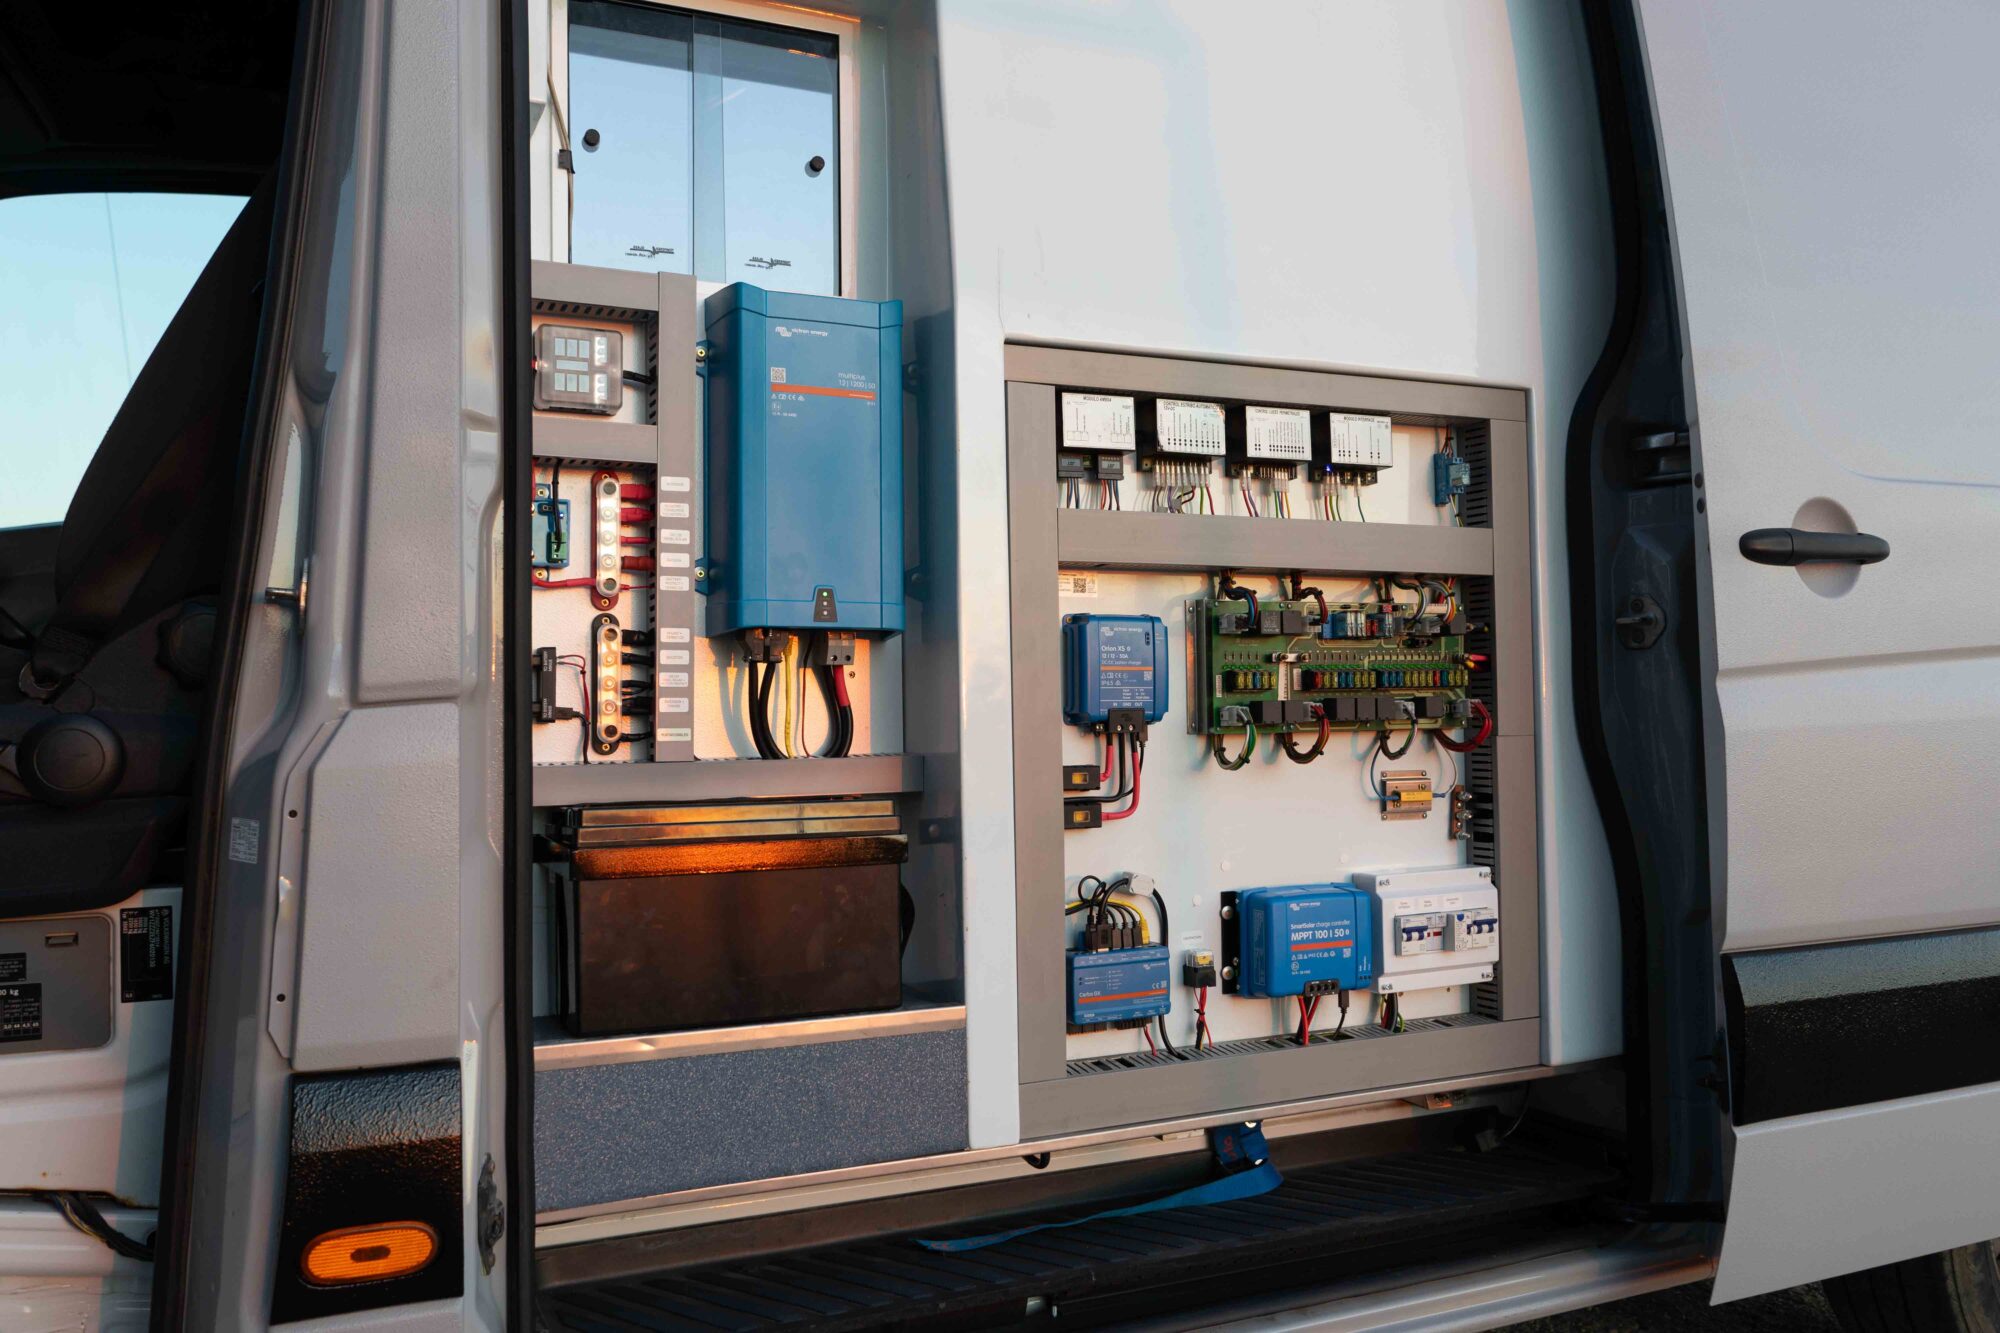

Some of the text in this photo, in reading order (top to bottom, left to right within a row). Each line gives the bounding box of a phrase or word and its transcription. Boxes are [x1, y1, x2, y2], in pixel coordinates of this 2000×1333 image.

[1291, 931, 1312, 941] MPPT
[1314, 930, 1328, 938] 100
[1334, 928, 1344, 938] 50
